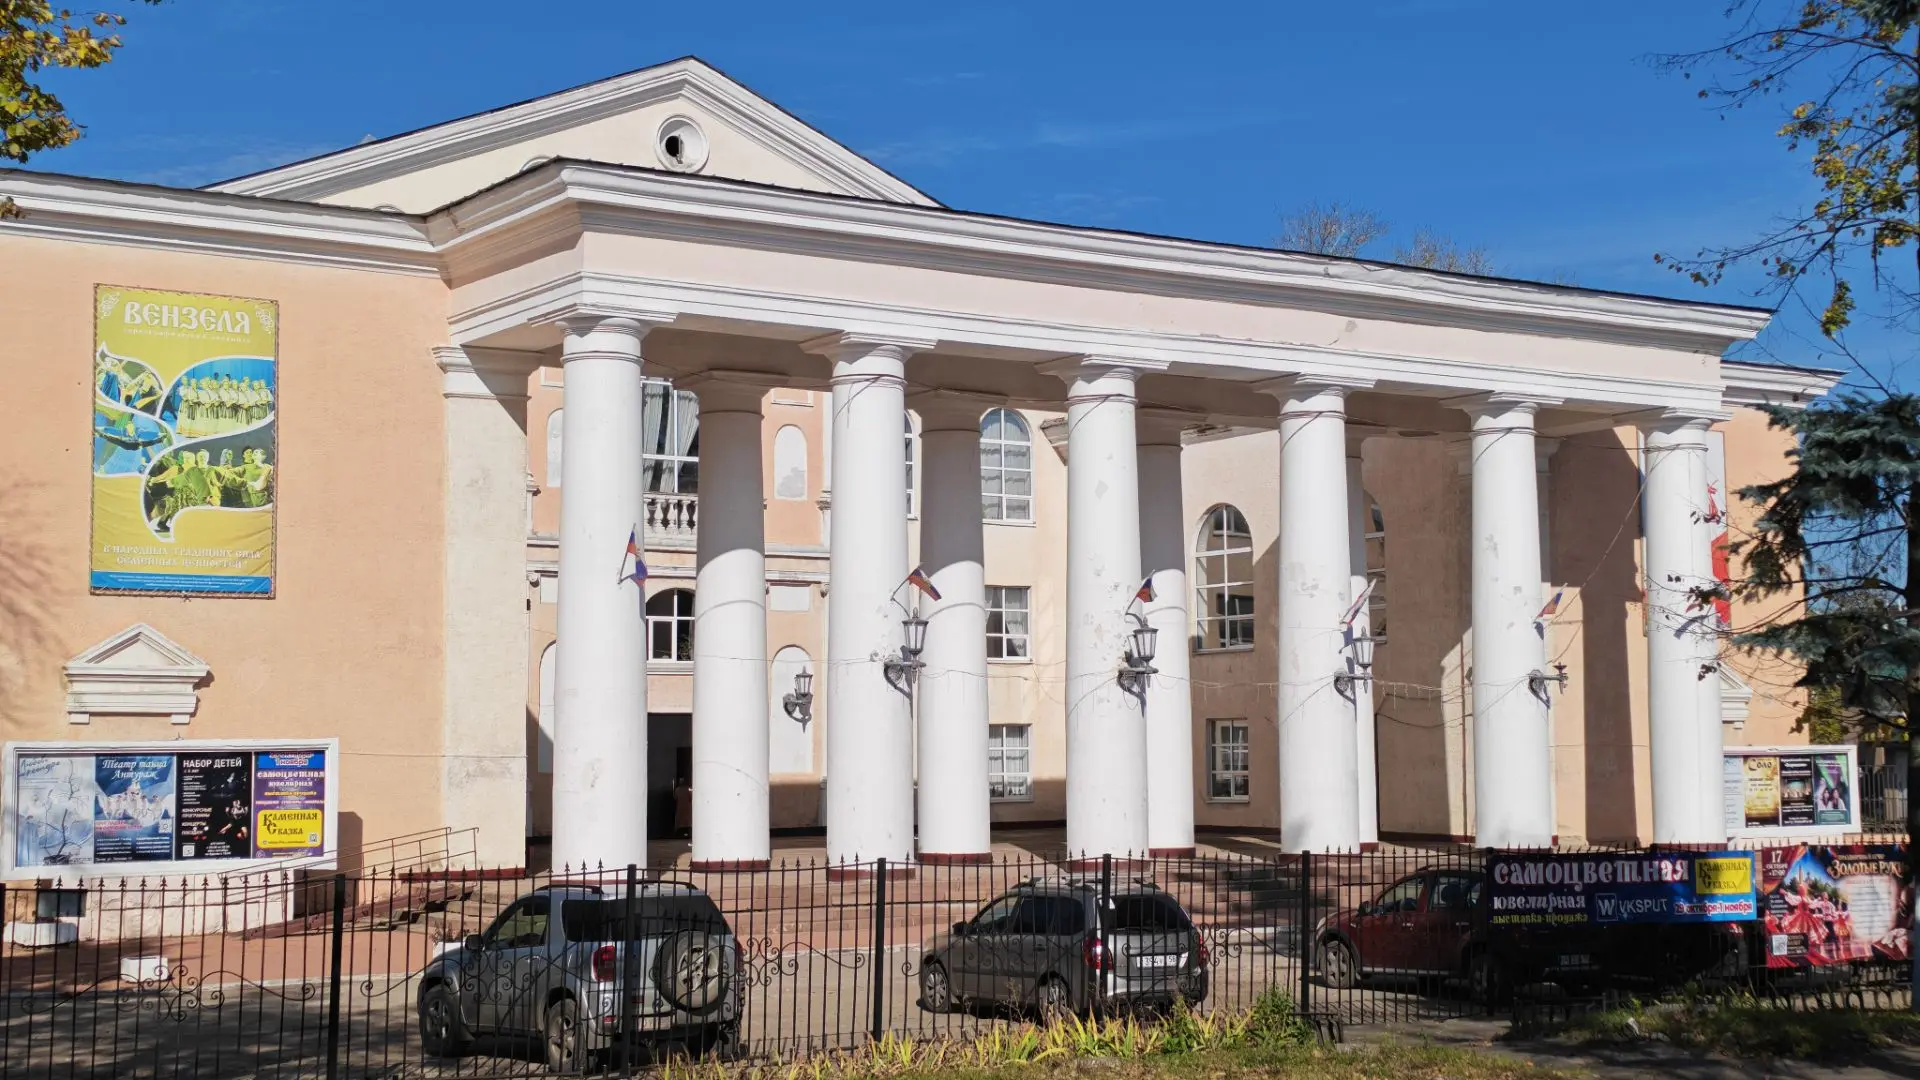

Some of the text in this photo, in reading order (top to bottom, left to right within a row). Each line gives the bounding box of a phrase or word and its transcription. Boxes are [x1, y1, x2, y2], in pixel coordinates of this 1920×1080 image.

[123, 301, 250, 335] ВЕНЗЕЛЯ
[102, 759, 137, 770] Театр
[182, 757, 242, 769] НАБОР ДЕТЕЙ
[1771, 850, 1783, 863] 17
[1494, 858, 1690, 892] самоцветная
[1493, 893, 1587, 912] ювелирная
[1724, 901, 1753, 914] ноября
